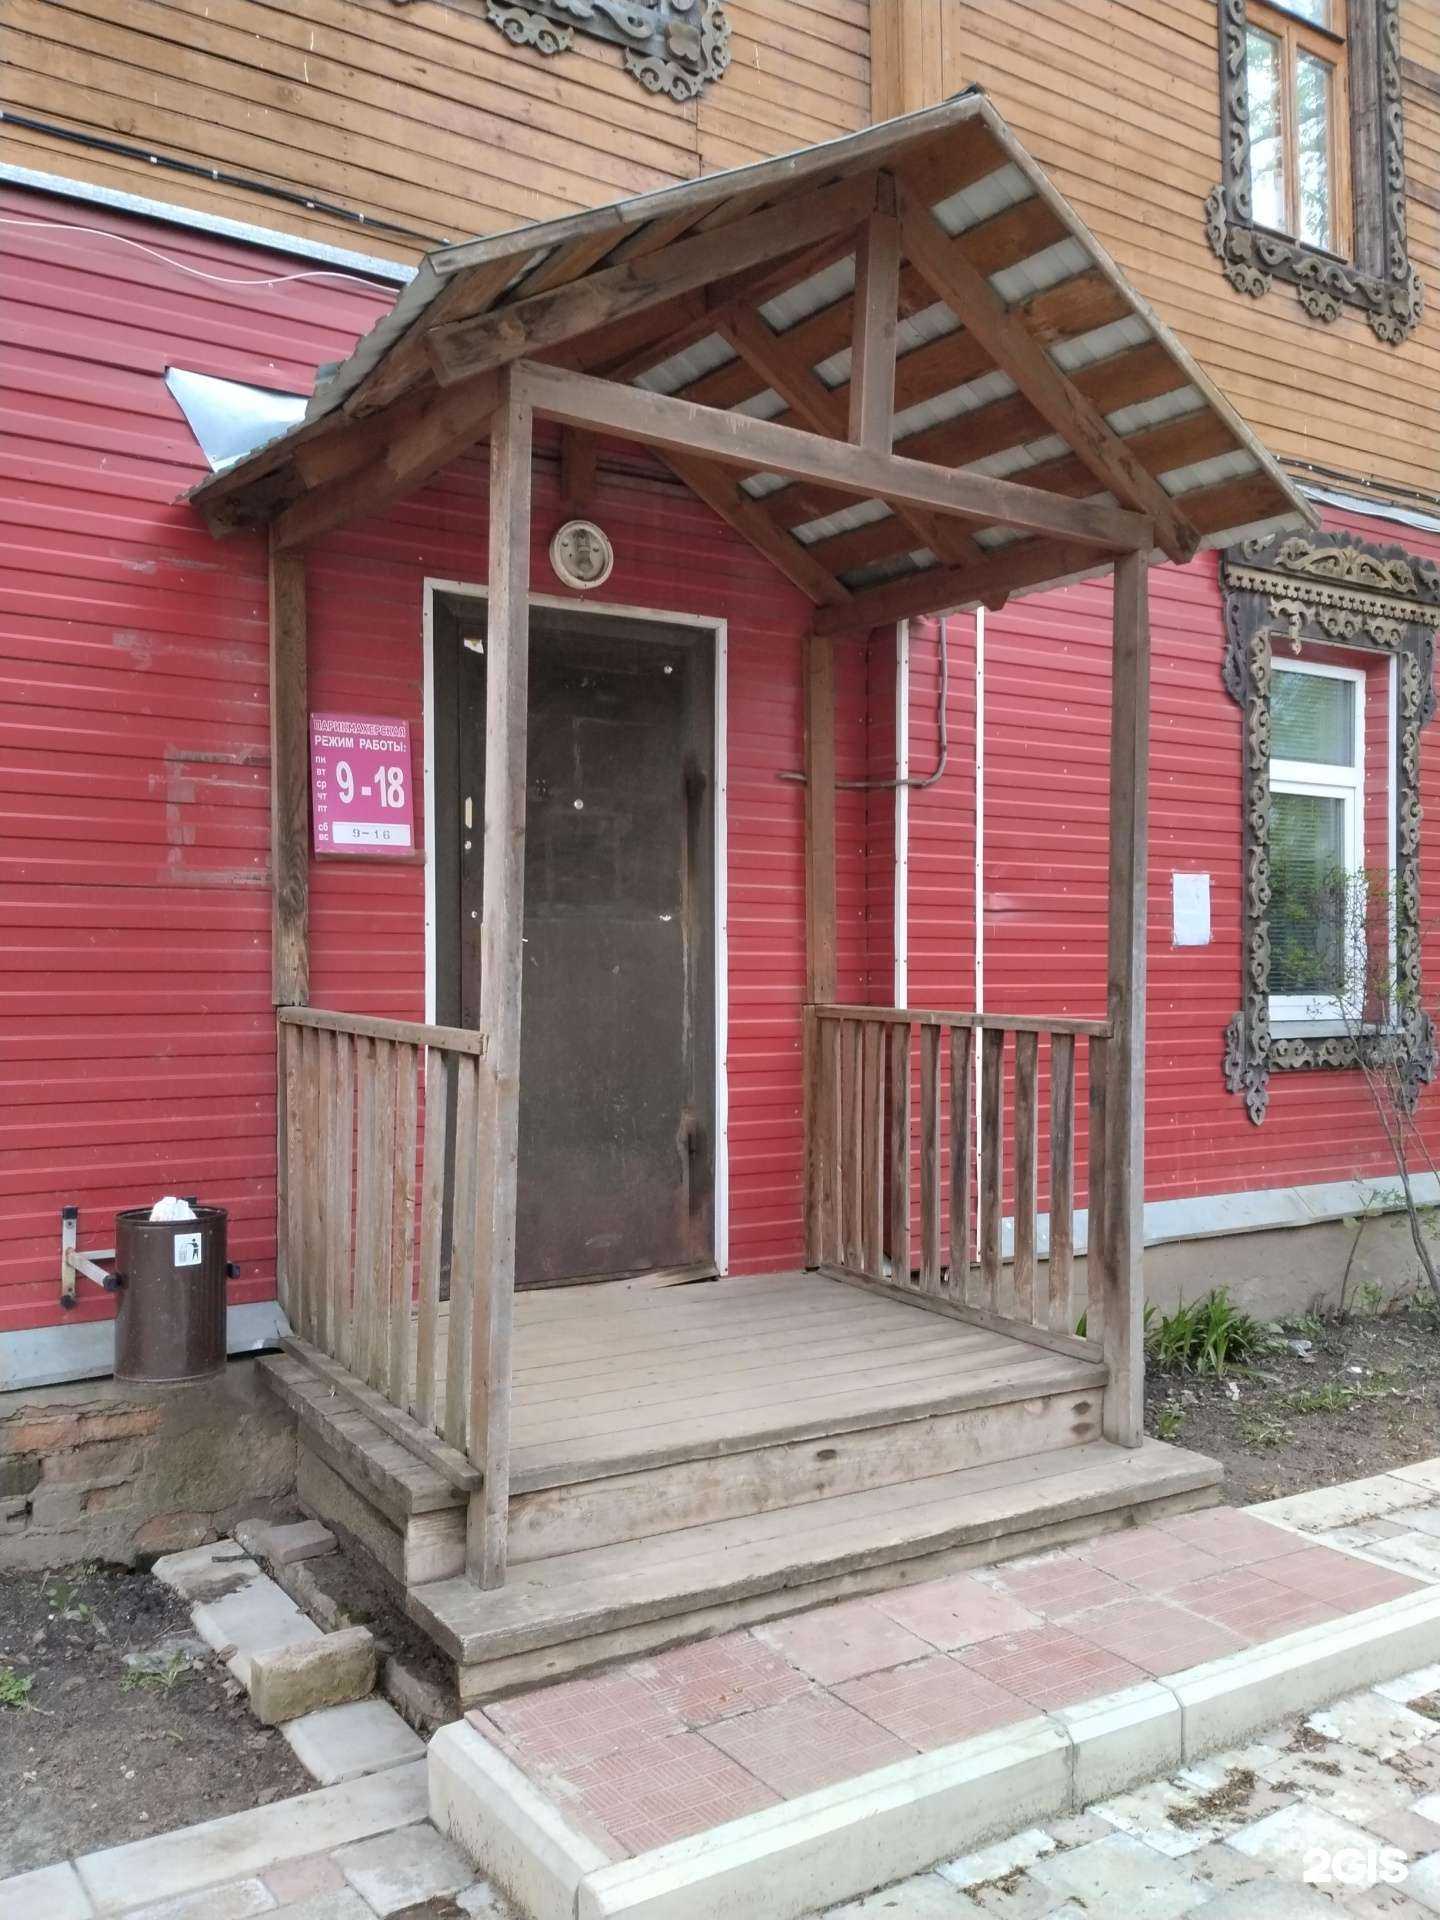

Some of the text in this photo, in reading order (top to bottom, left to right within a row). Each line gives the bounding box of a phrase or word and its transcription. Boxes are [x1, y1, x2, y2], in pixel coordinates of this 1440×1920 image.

[314, 735, 407, 753] РЕЖИМ РАБОТЫ:
[315, 756, 327, 764] пн
[316, 768, 327, 776] вт
[316, 780, 327, 790] ср
[318, 822, 328, 832] сб
[318, 833, 329, 841] вс
